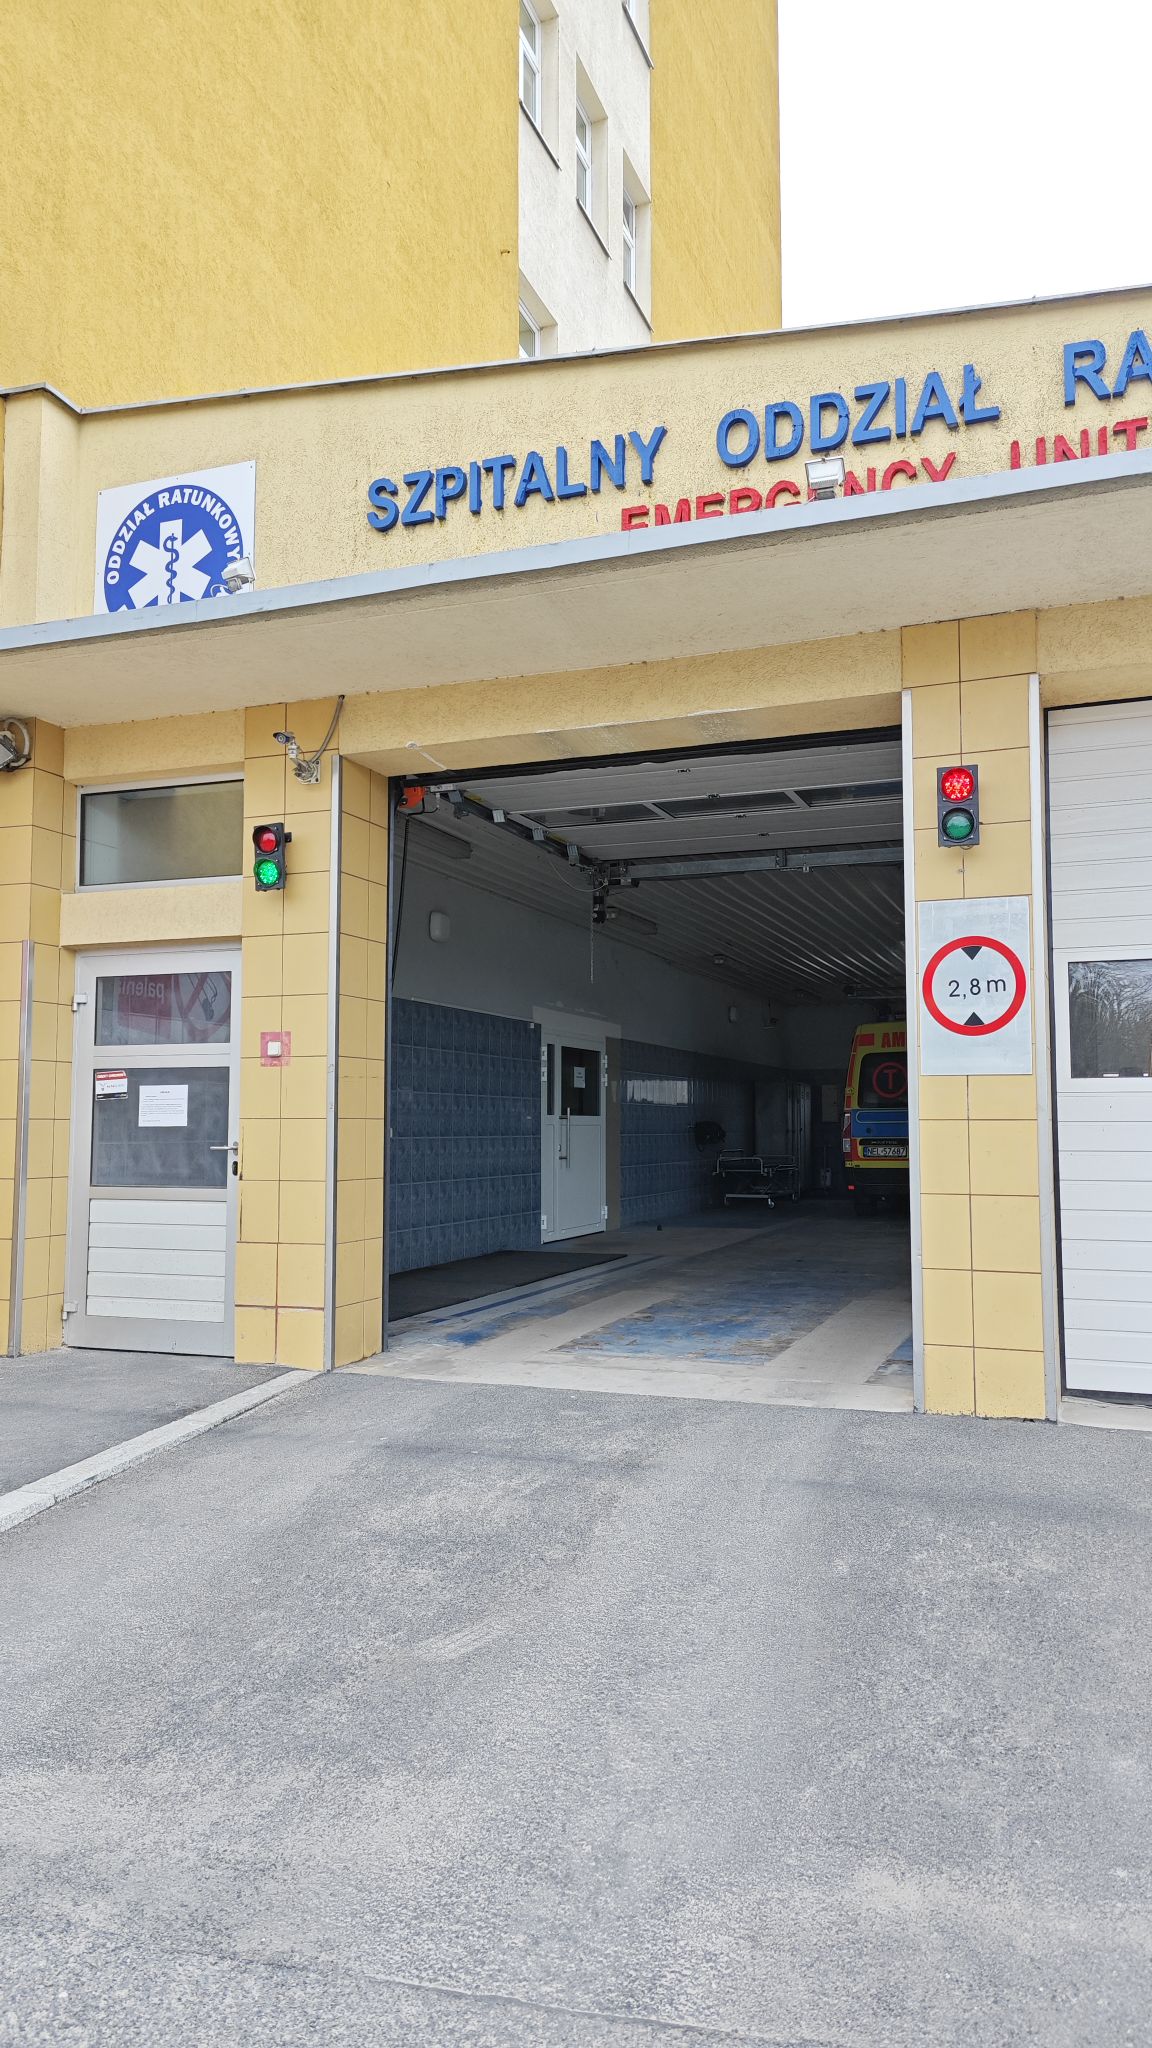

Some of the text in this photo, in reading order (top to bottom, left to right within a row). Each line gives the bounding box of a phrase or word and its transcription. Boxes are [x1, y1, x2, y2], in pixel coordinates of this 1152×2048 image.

[366, 329, 1152, 532] SZPITALNY ODDZIAŁ RA
[106, 488, 241, 585] ODDZIAŁ RATUNKOWY
[948, 978, 1007, 1000] 2,8 m
[882, 1069, 897, 1090] T
